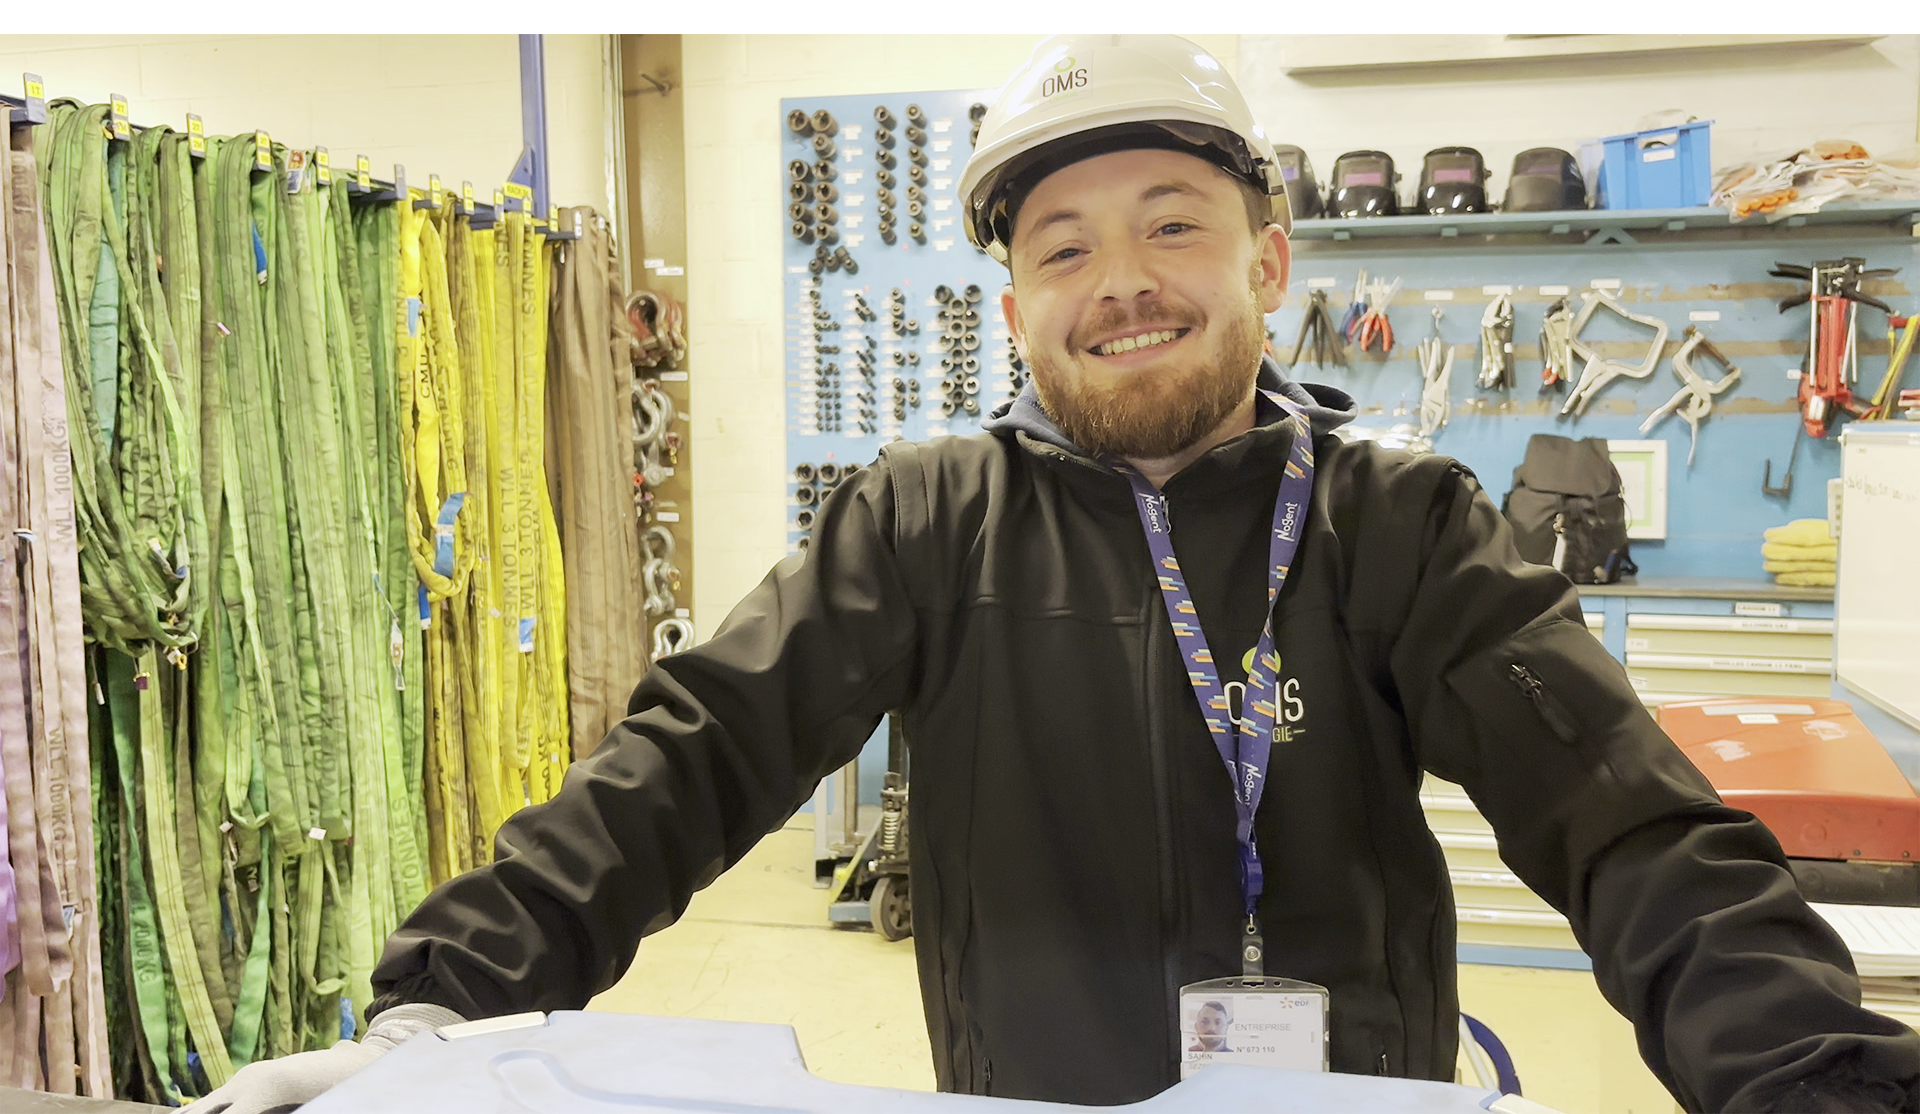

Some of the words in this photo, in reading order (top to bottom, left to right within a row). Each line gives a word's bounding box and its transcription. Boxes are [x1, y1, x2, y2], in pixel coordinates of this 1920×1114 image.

[31, 85, 41, 96] 1T
[1042, 68, 1088, 98] OMS
[116, 104, 126, 113] 2T
[420, 354, 431, 399] CMU
[499, 467, 514, 513] WLL
[55, 501, 73, 543] WLL
[502, 522, 516, 534] 3
[1138, 492, 1162, 534] Nogent
[1274, 502, 1298, 542] Nogent
[520, 544, 534, 557] 3
[503, 541, 518, 628] TONNES
[520, 570, 535, 610] WLL
[49, 728, 65, 768] WLL
[1241, 762, 1262, 806] Nogent
[50, 773, 68, 841] 1000KG
[391, 796, 422, 894] TONNES
[1235, 1023, 1291, 1031] ENTREPRISE
